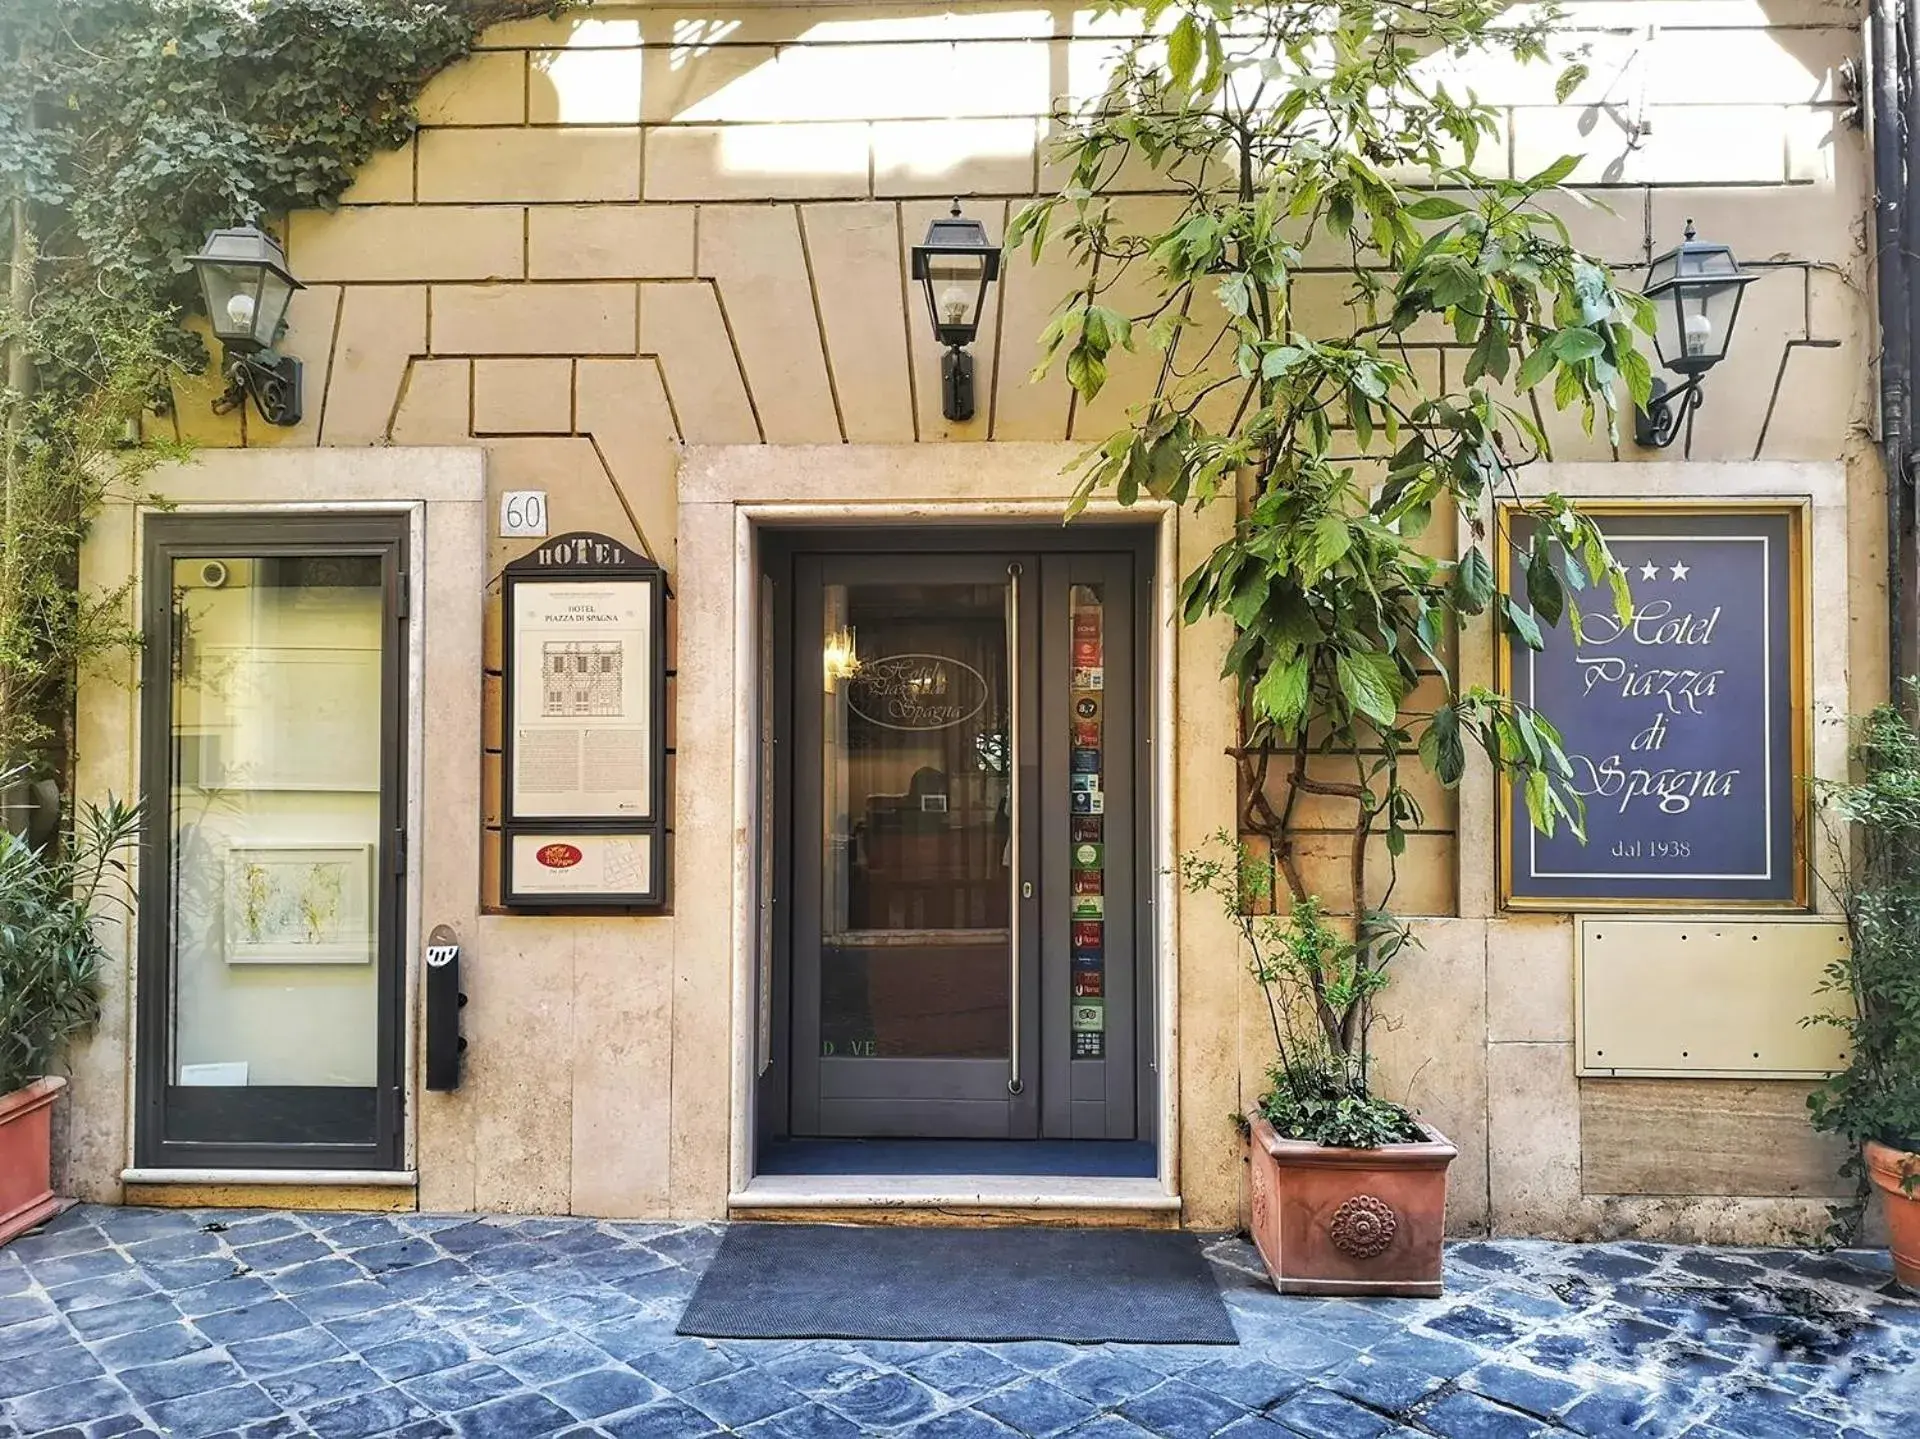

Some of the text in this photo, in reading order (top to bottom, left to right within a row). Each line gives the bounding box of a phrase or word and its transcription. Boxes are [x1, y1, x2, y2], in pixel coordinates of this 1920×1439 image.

[506, 496, 541, 529] 60
[537, 538, 626, 565] HOTEL
[545, 614, 575, 622] PIAZZA
[586, 614, 618, 622] SPAGNA
[568, 605, 595, 613] HOTEL
[1580, 600, 1721, 646] Hotel
[1575, 654, 1725, 714] Piazza
[1630, 711, 1670, 752] di
[1565, 754, 1741, 815] Spagna
[1611, 839, 1691, 858] dal 1938
